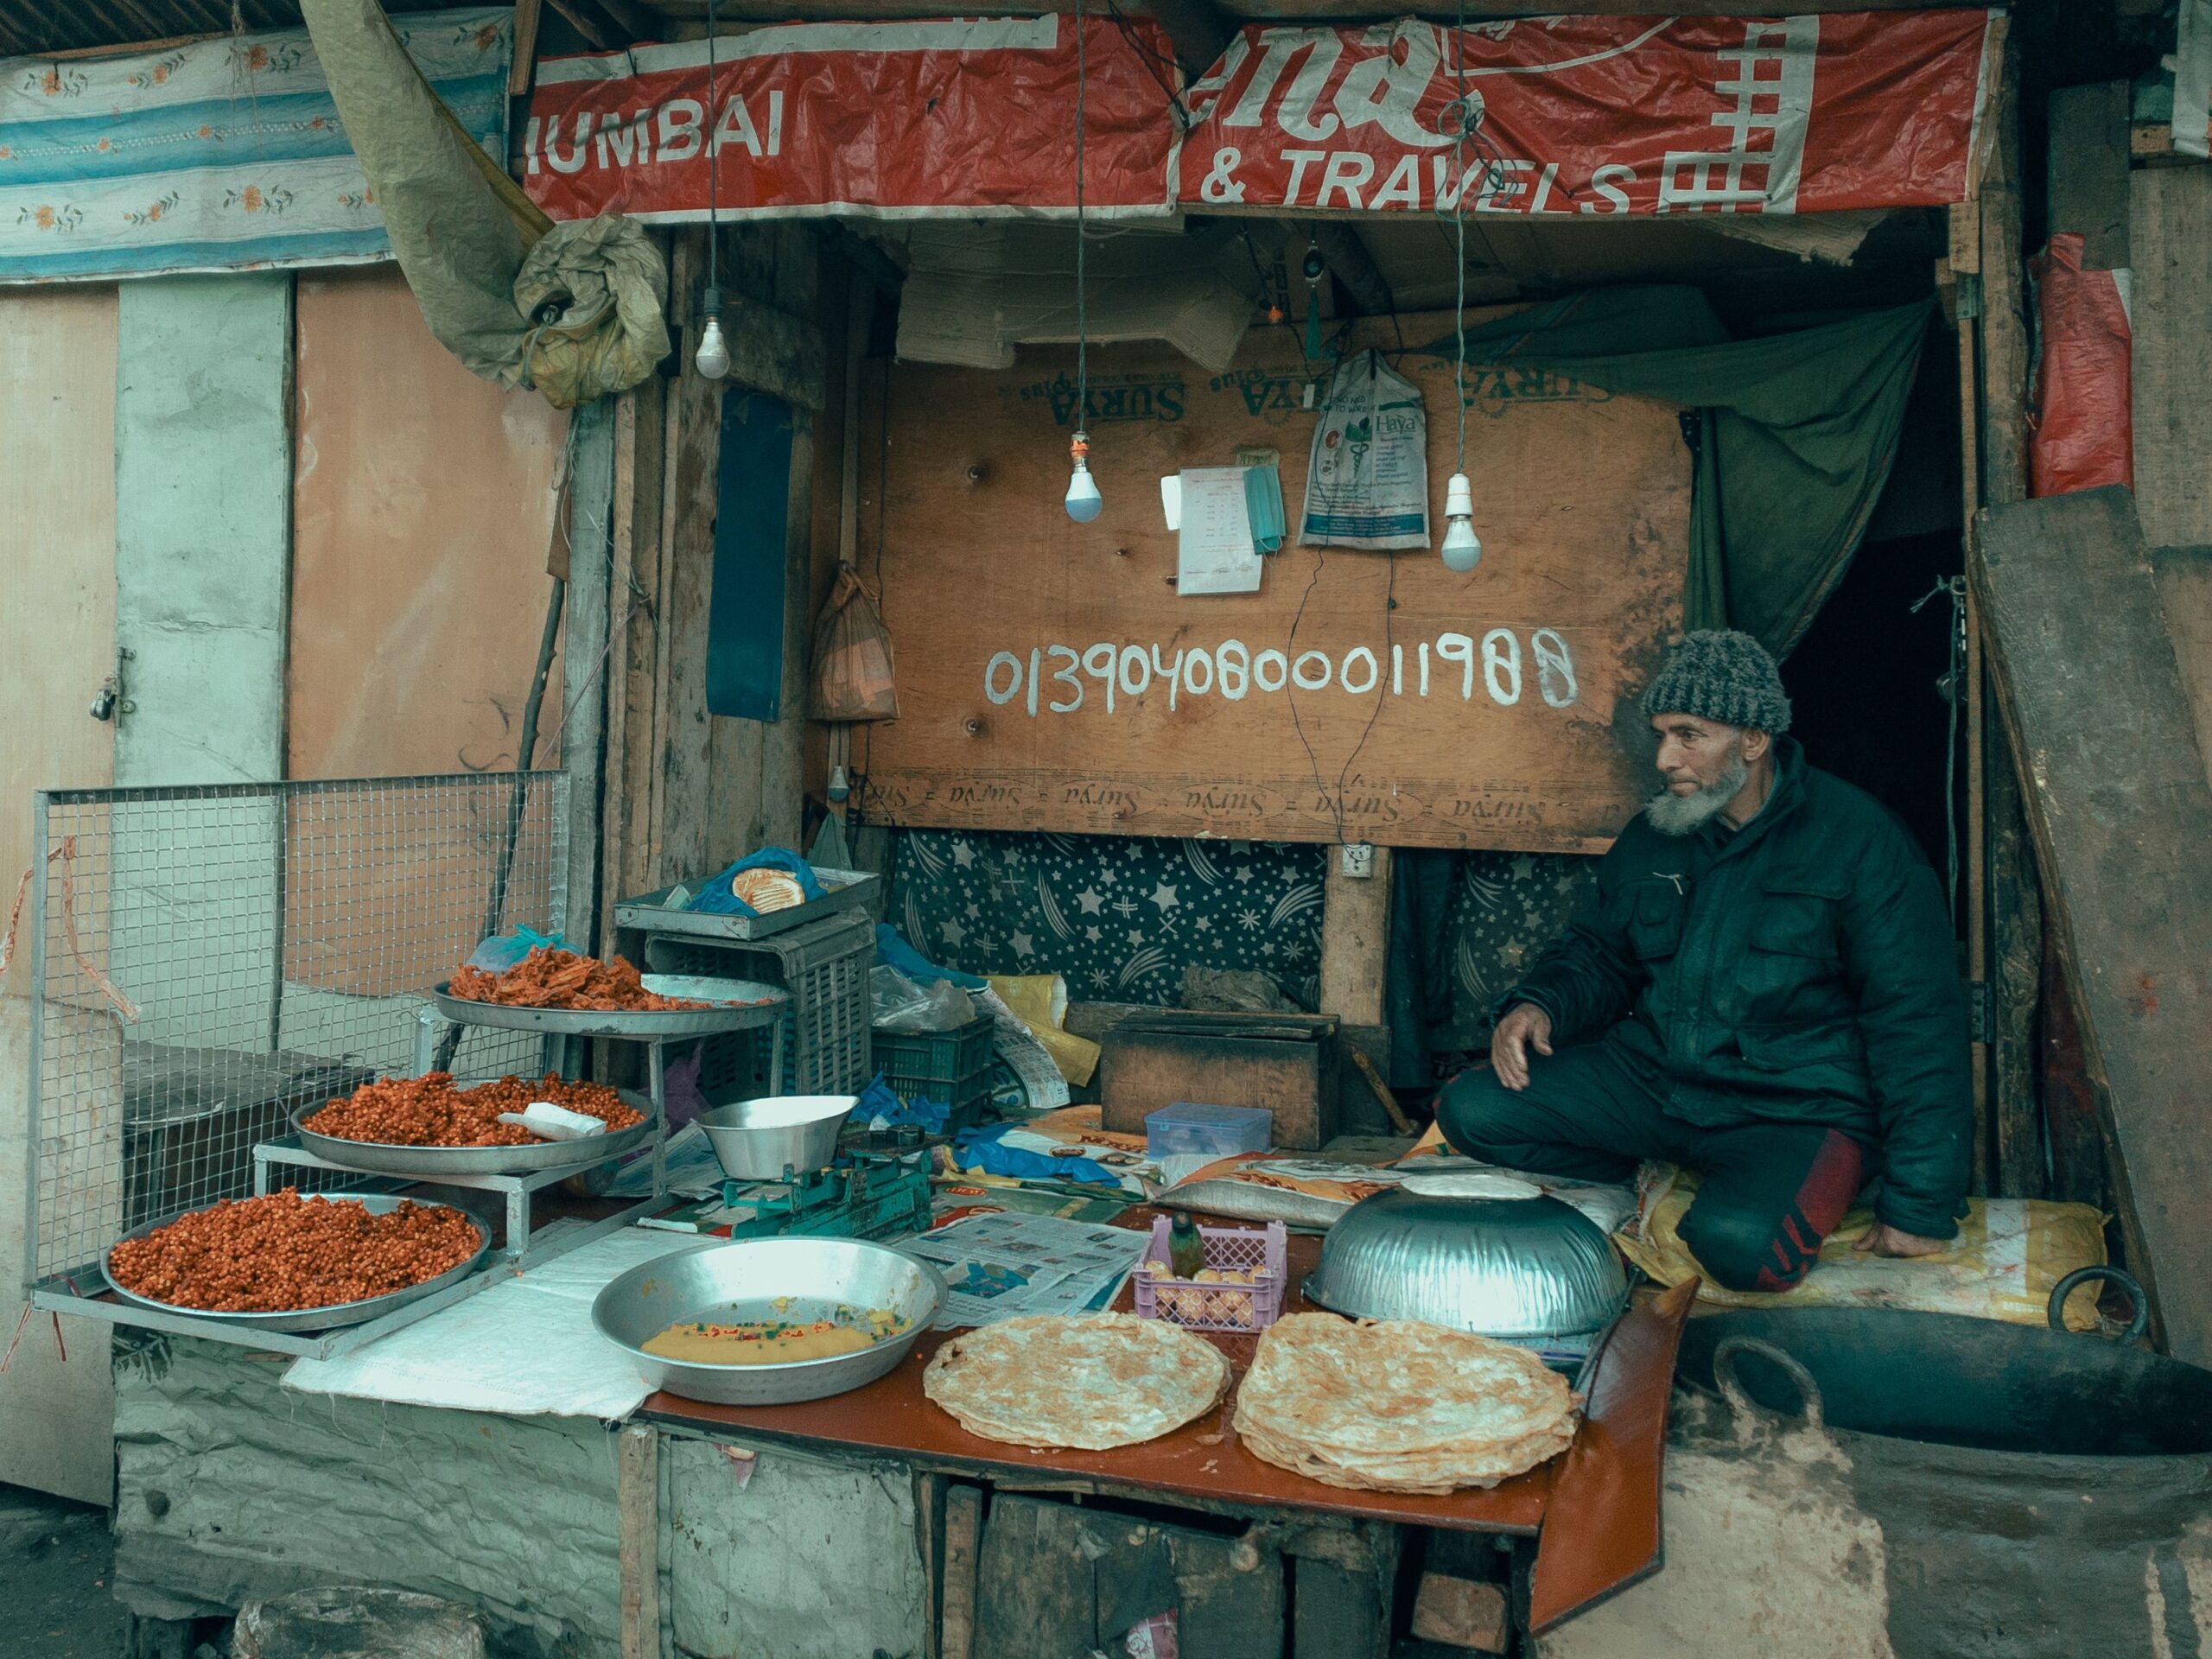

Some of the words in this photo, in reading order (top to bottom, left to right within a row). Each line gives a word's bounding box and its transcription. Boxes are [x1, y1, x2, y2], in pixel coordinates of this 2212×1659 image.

[1200, 147, 1246, 203] &
[1280, 149, 1637, 213] TRAVELS
[1049, 385, 1185, 424] SURYA
[1456, 366, 1615, 407] URYA
[1065, 782, 1140, 812] Surya
[1185, 785, 1267, 817] Surya
